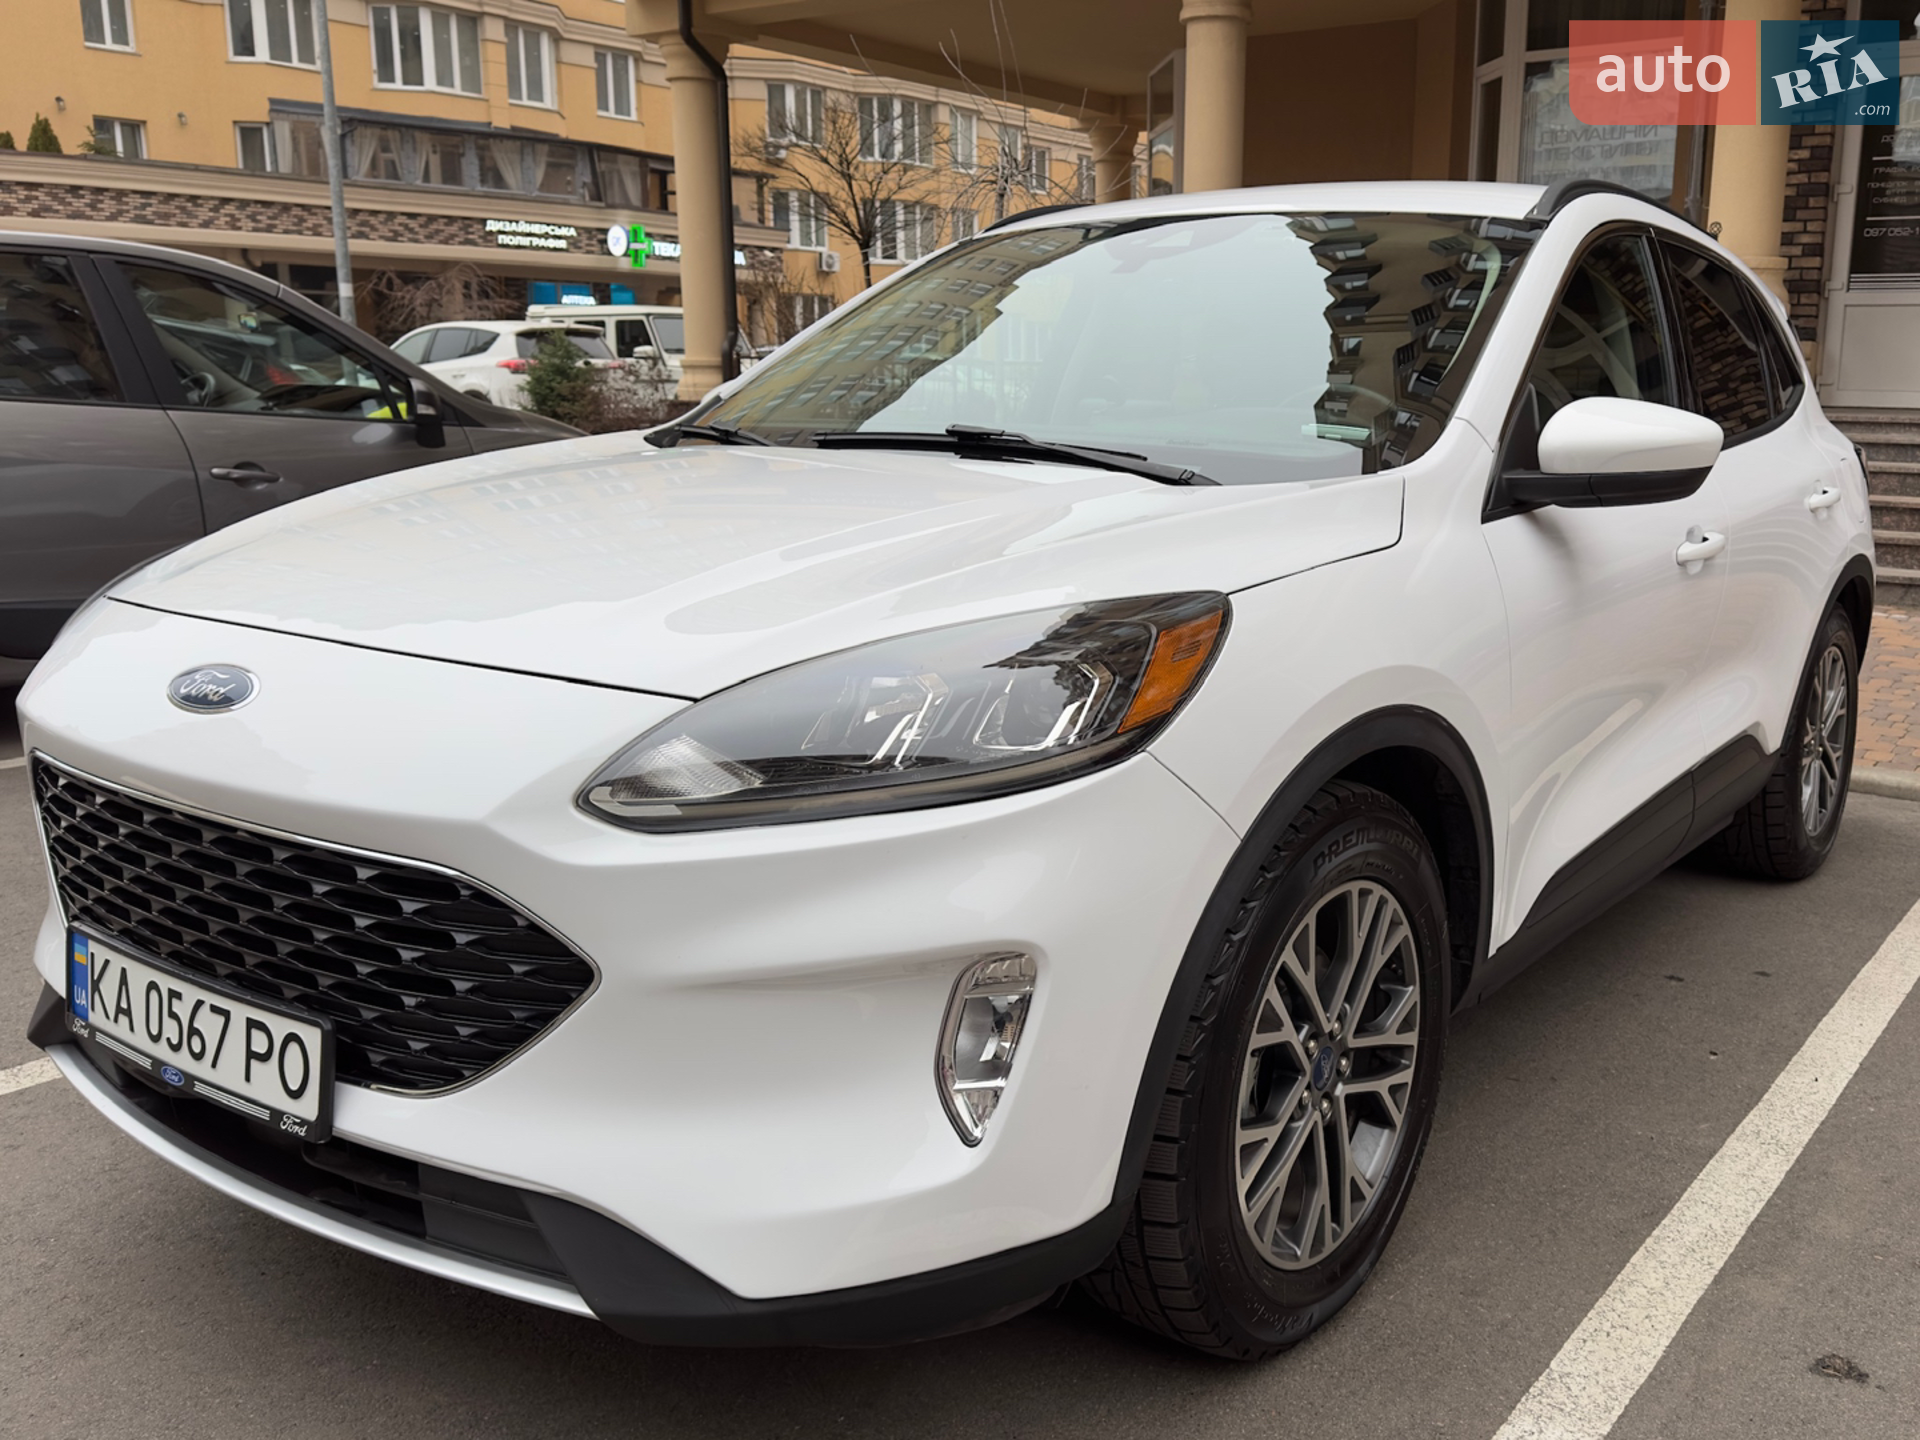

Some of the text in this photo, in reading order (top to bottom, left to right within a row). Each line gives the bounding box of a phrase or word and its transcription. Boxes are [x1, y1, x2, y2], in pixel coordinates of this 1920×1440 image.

[485, 219, 577, 237] ДИЗАЙНЕРСЬКА
[1863, 227, 1887, 237] 097
[497, 234, 568, 249] ПОЛІГРАФІЯ
[179, 669, 236, 702] Ford
[74, 984, 88, 1009] UA
[72, 1017, 89, 1038] Ford
[90, 951, 310, 1101] KA 0567 PO
[279, 1112, 308, 1137] Ford
